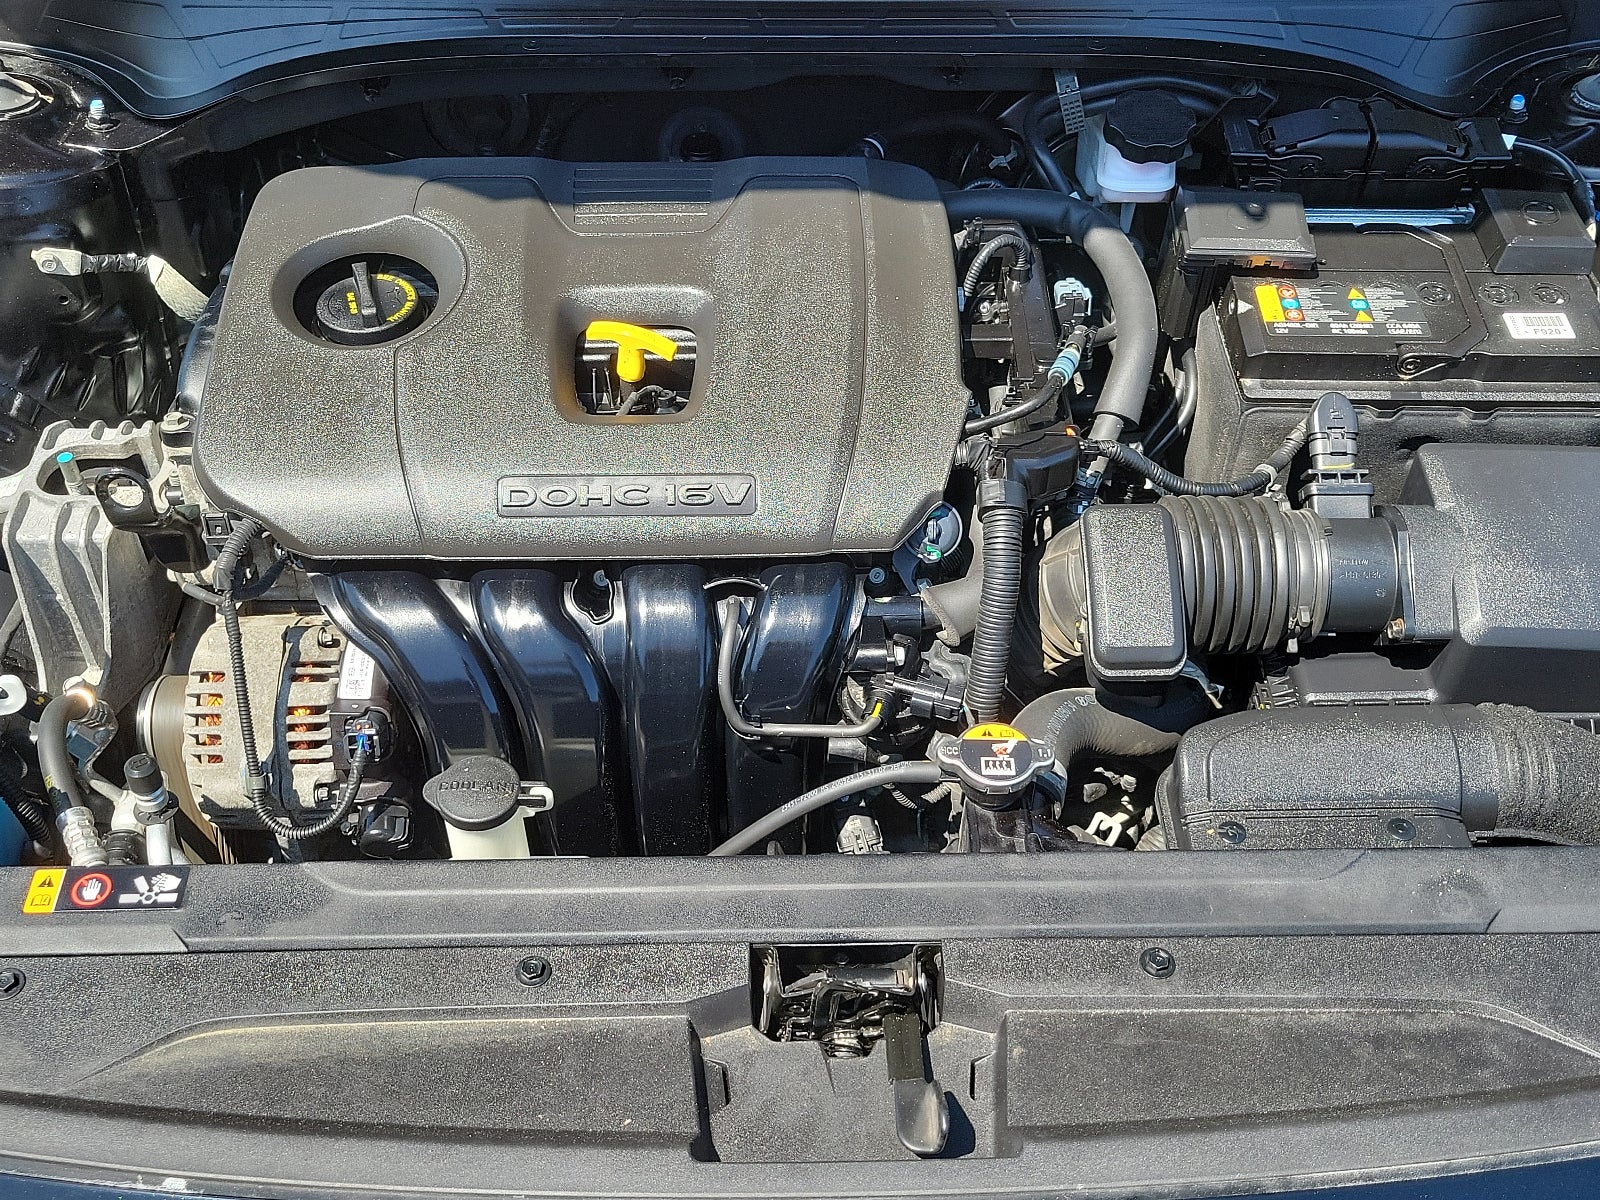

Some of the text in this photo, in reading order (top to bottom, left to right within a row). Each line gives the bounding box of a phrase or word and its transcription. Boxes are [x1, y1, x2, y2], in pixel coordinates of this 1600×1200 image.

[385, 301, 415, 322] MANUAL
[502, 482, 752, 507] DOHC 16V
[440, 780, 518, 793] COOLANT
